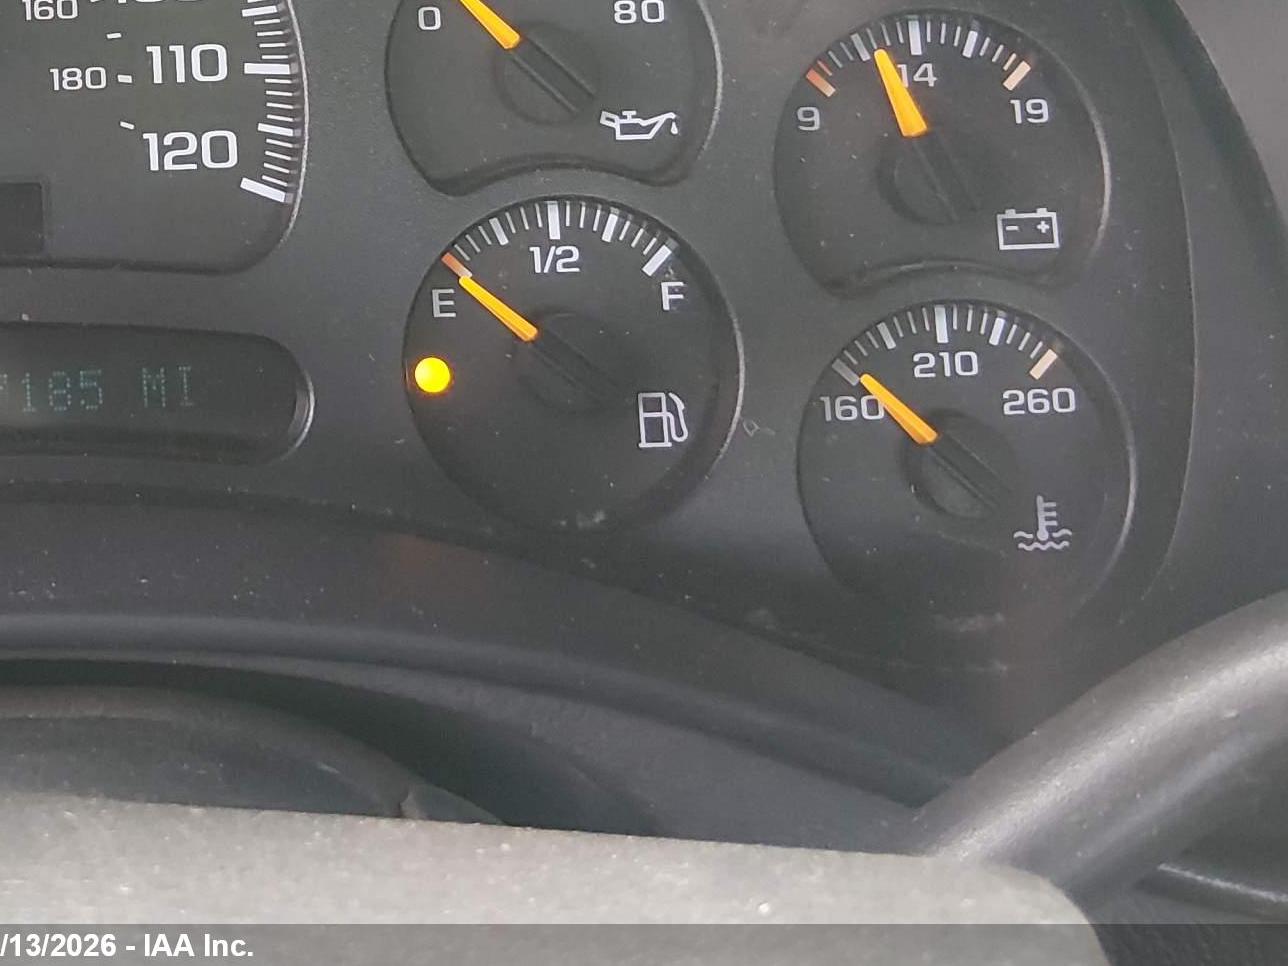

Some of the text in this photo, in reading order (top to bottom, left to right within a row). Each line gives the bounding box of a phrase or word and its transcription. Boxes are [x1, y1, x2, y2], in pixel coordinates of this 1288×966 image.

[418, 6, 442, 31] 0
[146, 43, 228, 84] 110
[896, 63, 938, 89] 14
[49, 66, 107, 91] 180
[797, 106, 821, 131] 9
[1010, 98, 1049, 124] 19
[142, 130, 238, 171] 120
[529, 245, 580, 274] 1/2
[432, 288, 457, 318] E
[660, 281, 685, 311] F
[913, 351, 979, 378] 210
[142, 365, 193, 408] MI
[819, 394, 884, 421] 160
[1002, 387, 1076, 415] 260
